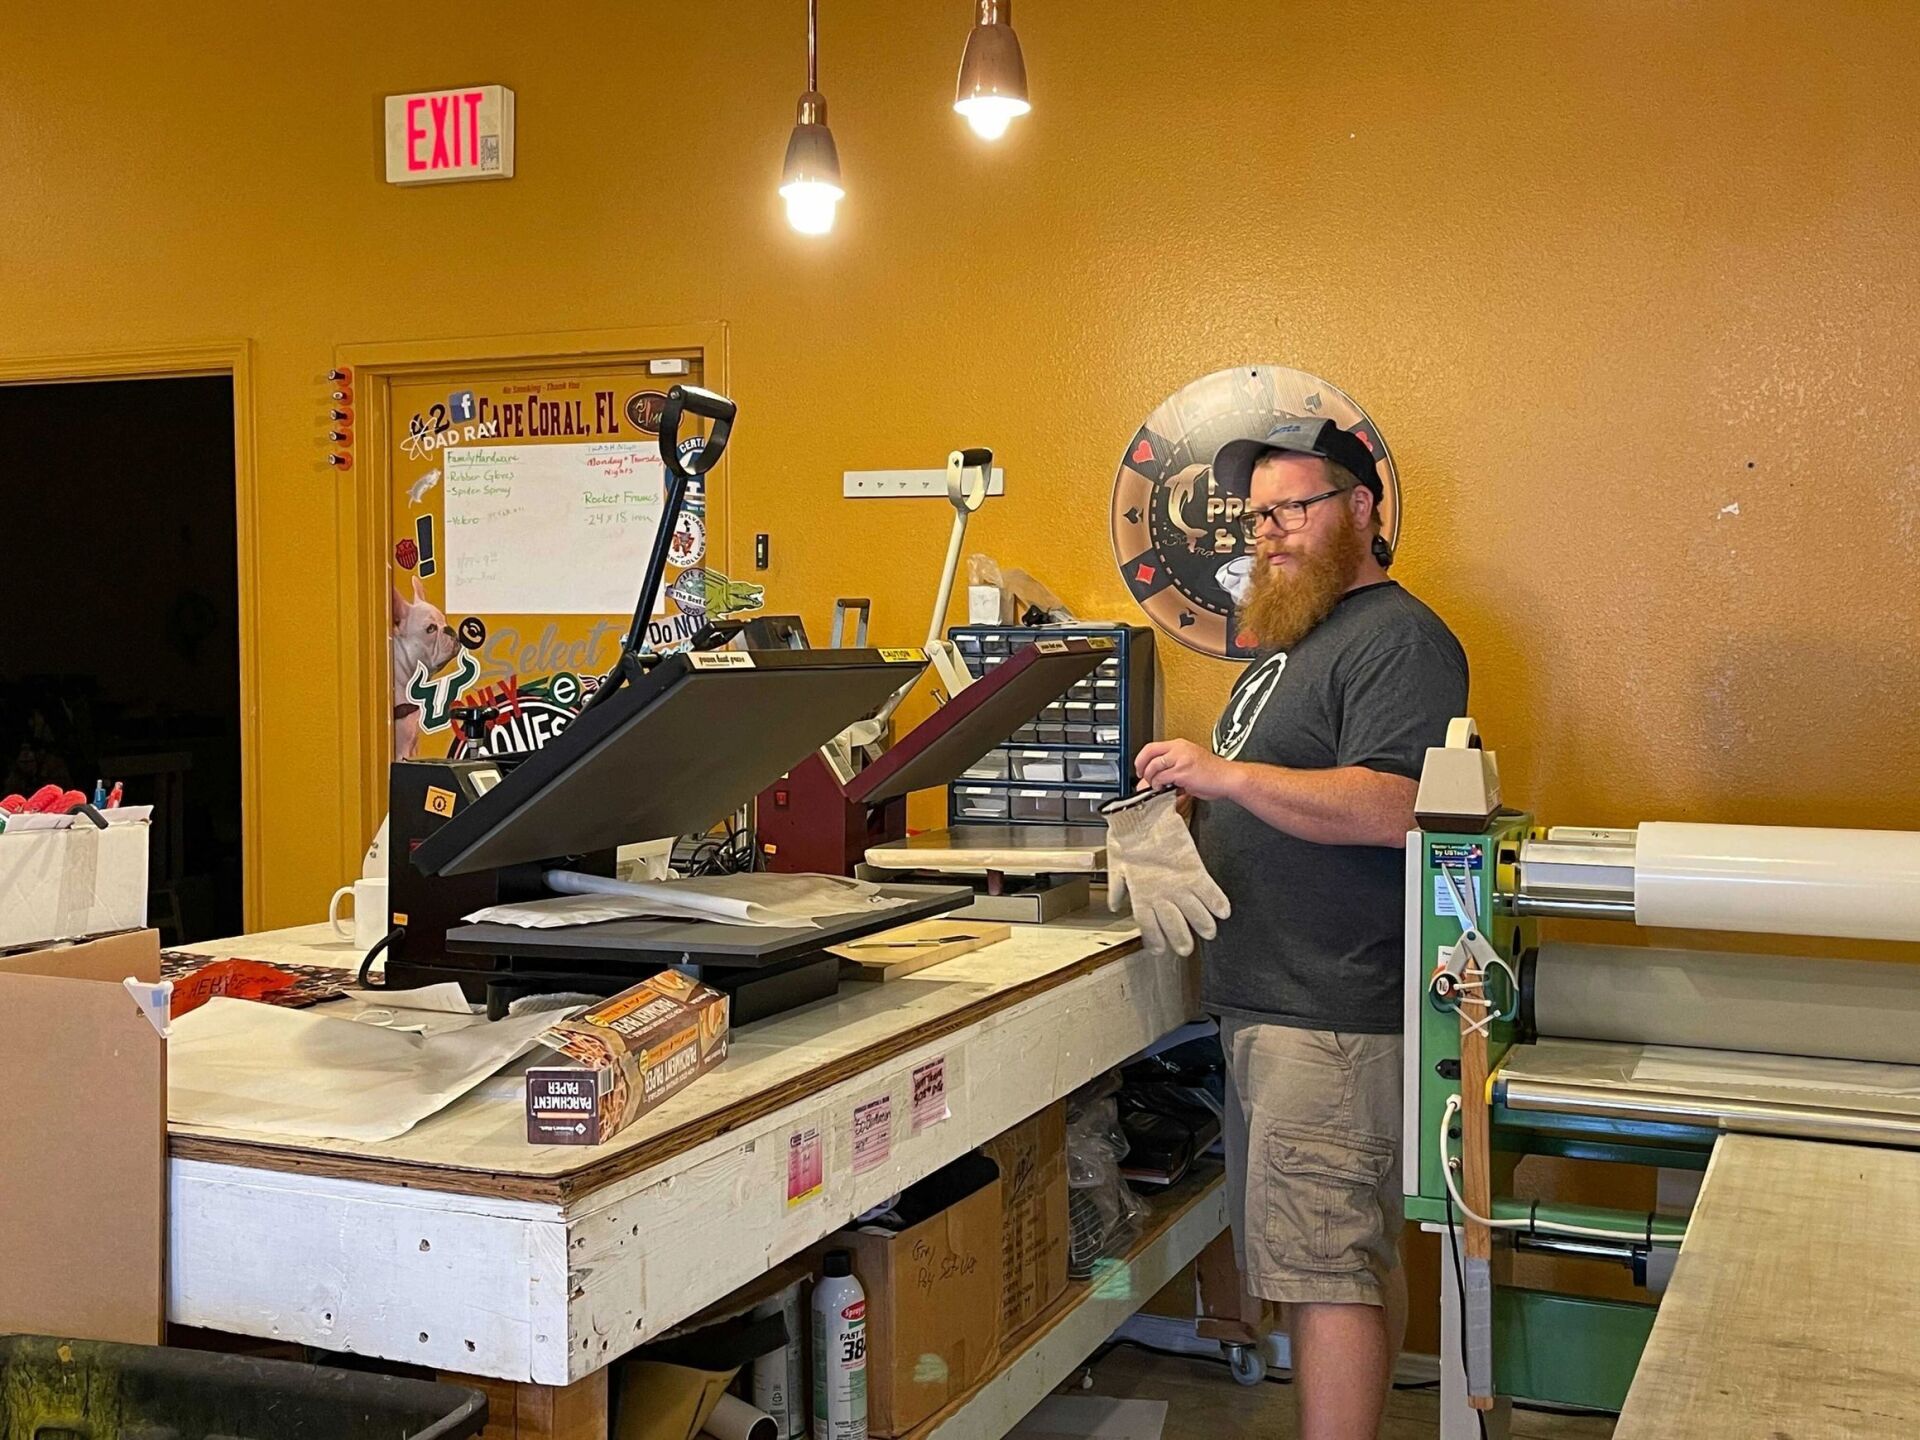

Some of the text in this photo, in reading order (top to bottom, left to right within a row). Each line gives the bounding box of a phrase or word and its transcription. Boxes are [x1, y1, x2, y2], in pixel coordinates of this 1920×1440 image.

[407, 92, 482, 171] EXIT
[595, 391, 619, 434] FL
[423, 420, 497, 451] DAD RAY
[480, 621, 624, 678] Select
[533, 1096, 592, 1110] PARCHMENT
[547, 1081, 579, 1095] PAPER
[840, 1333, 859, 1341] FAST
